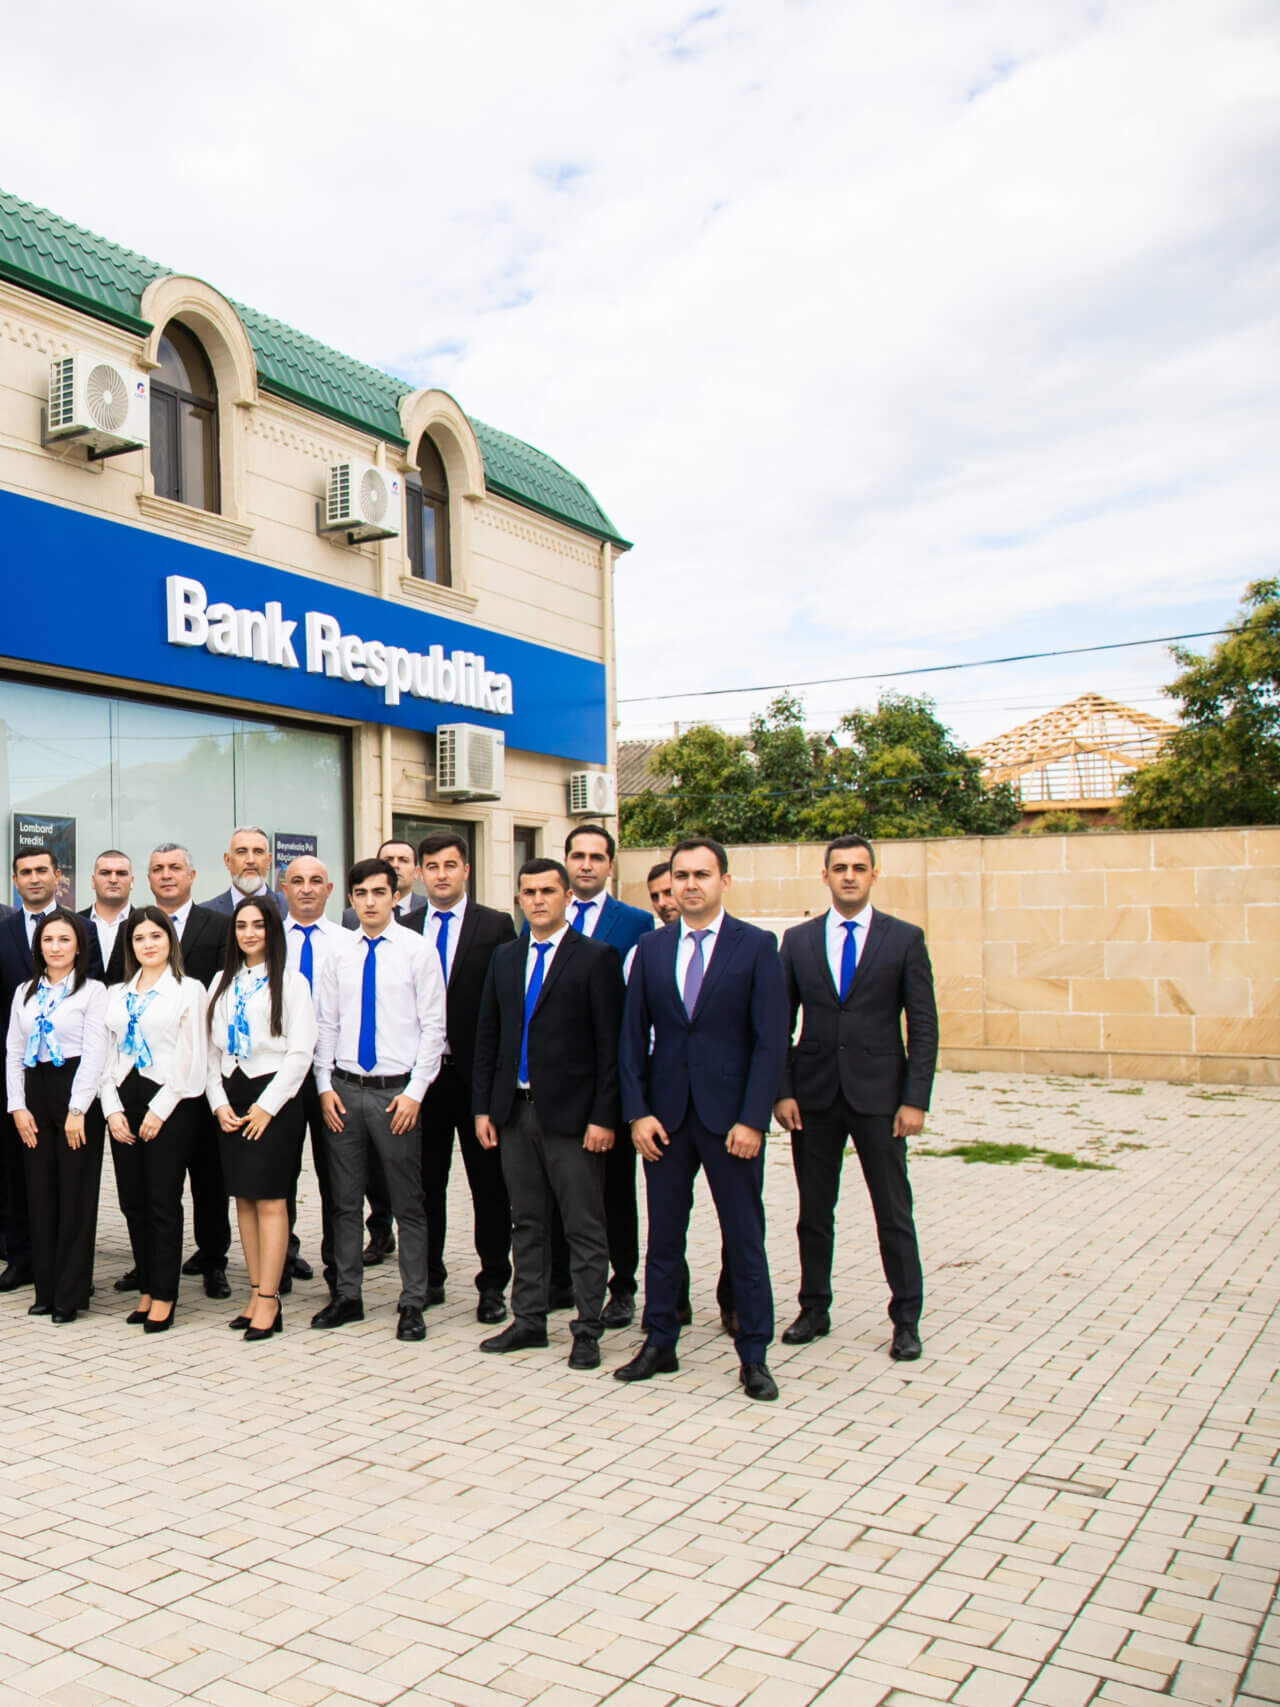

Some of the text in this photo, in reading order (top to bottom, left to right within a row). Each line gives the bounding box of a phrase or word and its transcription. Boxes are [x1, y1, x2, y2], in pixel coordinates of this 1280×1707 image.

[166, 575, 514, 715] Bank Respublika
[19, 822, 53, 834] Lombard
[19, 835, 44, 846] krediti
